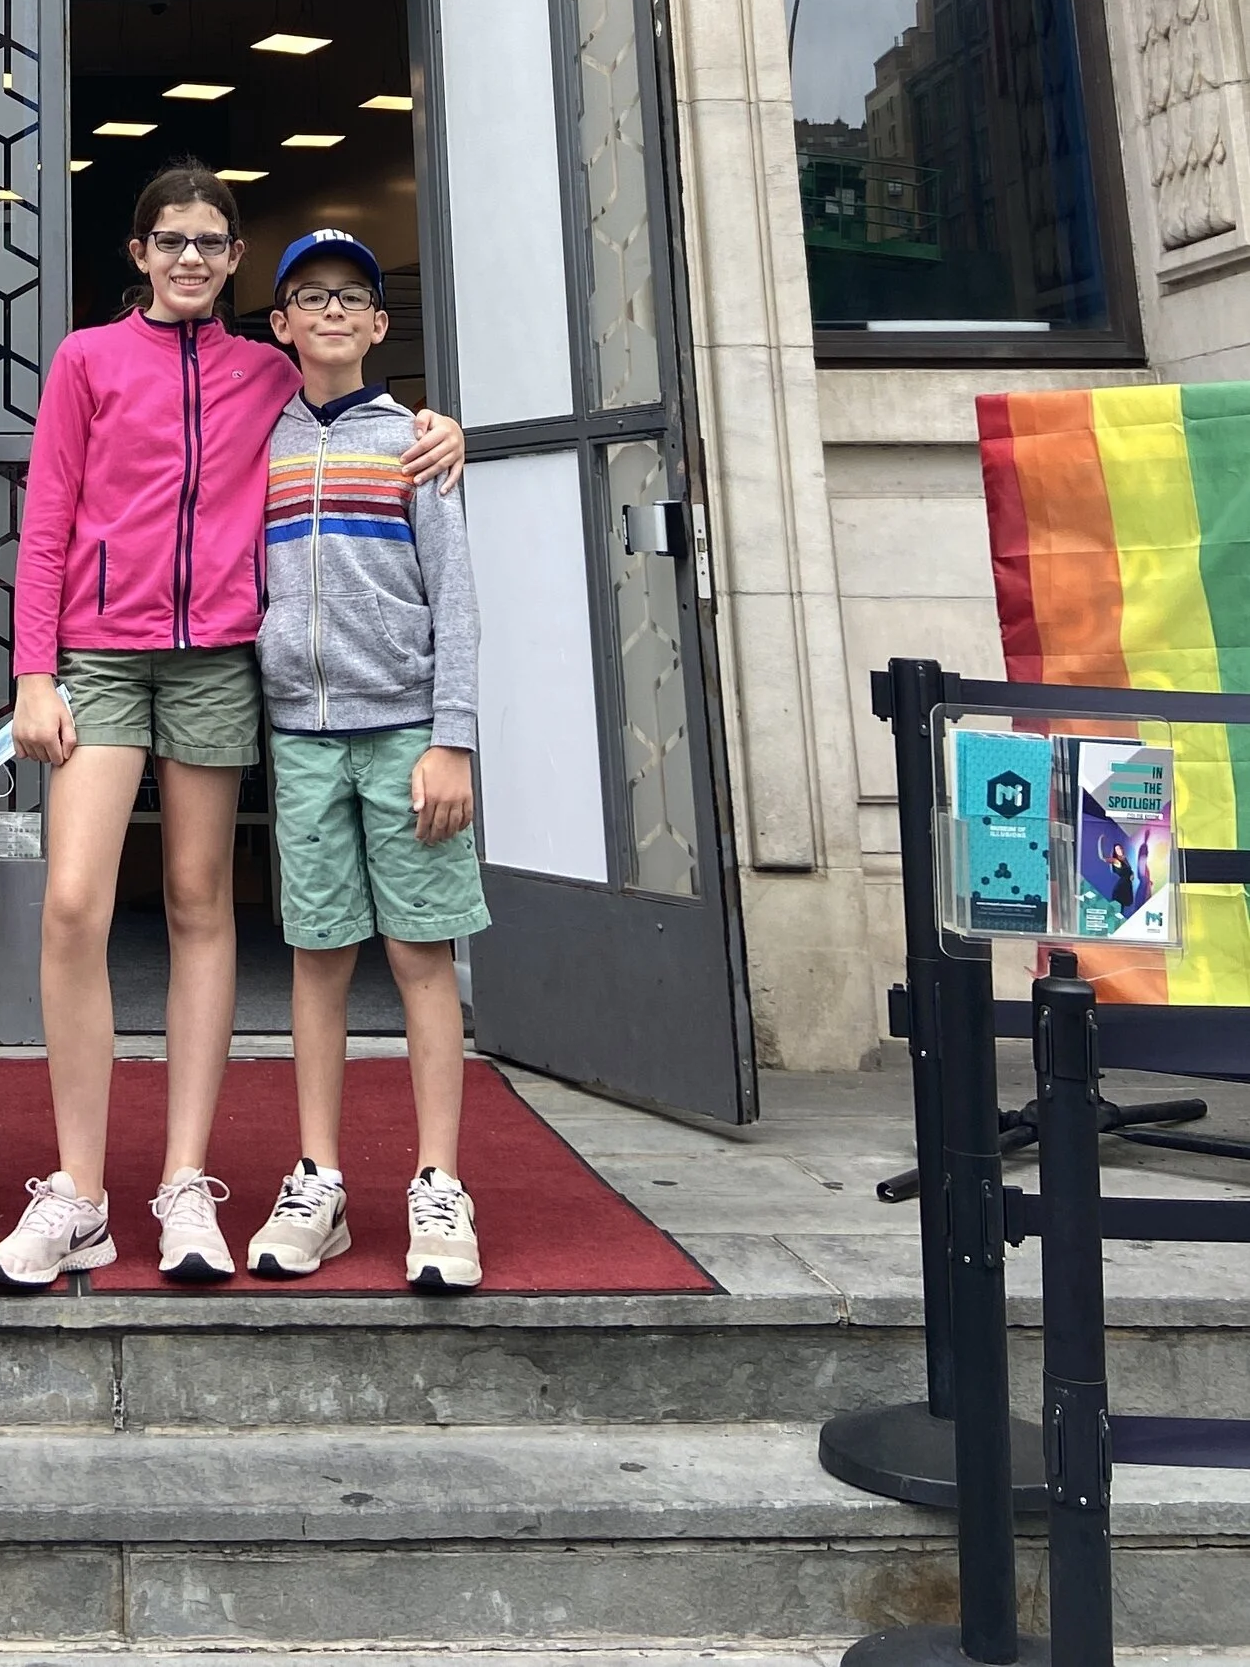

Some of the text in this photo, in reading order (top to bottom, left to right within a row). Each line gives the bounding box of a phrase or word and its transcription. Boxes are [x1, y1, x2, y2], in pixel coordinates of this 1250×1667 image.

[1152, 766, 1163, 779] IN
[1143, 782, 1162, 795] THE
[1108, 795, 1162, 811] SPOTLIGHT
